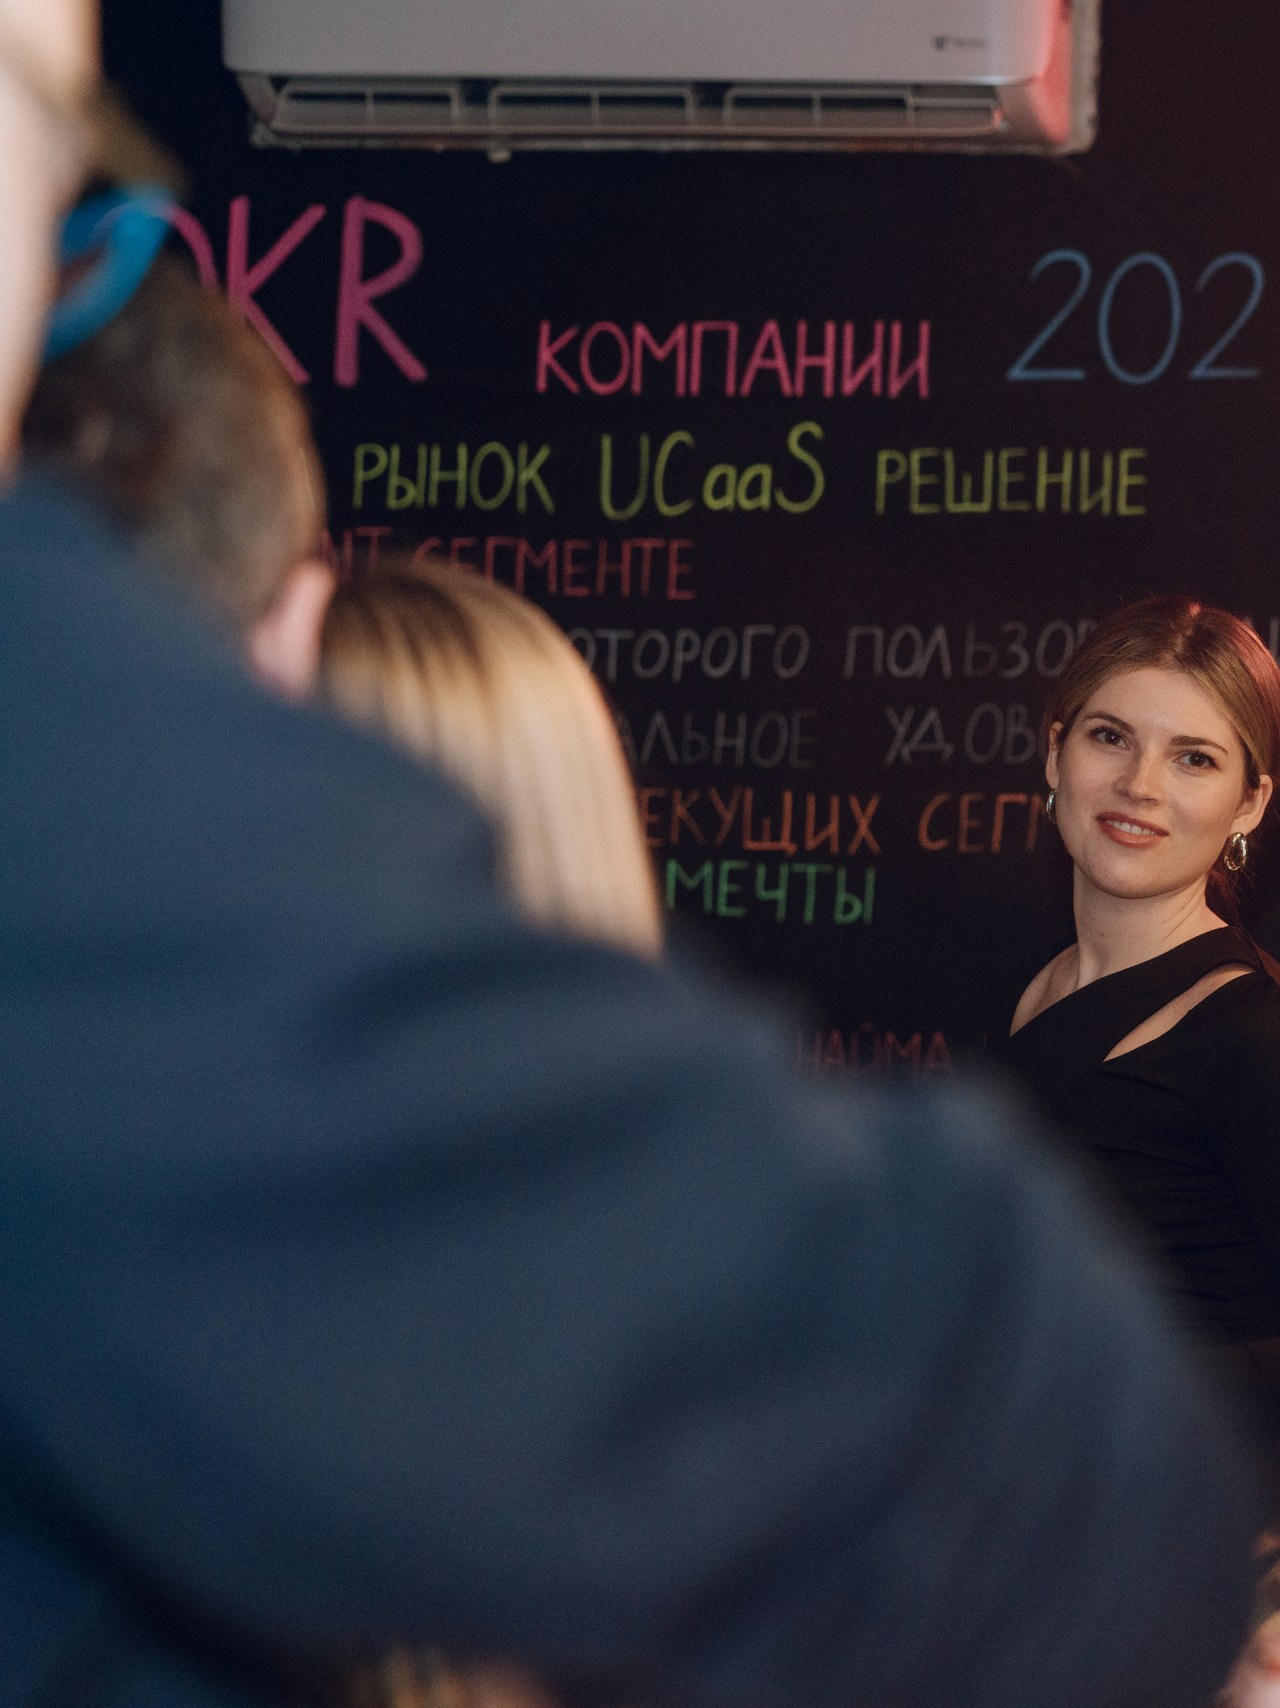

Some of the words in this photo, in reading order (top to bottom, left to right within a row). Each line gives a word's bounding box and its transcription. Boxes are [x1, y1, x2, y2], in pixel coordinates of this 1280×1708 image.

[535, 319, 930, 398] КОМПАНИИ
[352, 441, 556, 514] РЫНОК
[601, 421, 825, 520] UCaaS
[876, 447, 1148, 516] РЕШЕНИЕ
[844, 618, 1099, 680] ПОЛЬЗО
[665, 858, 877, 926] МЕЧТЫ
